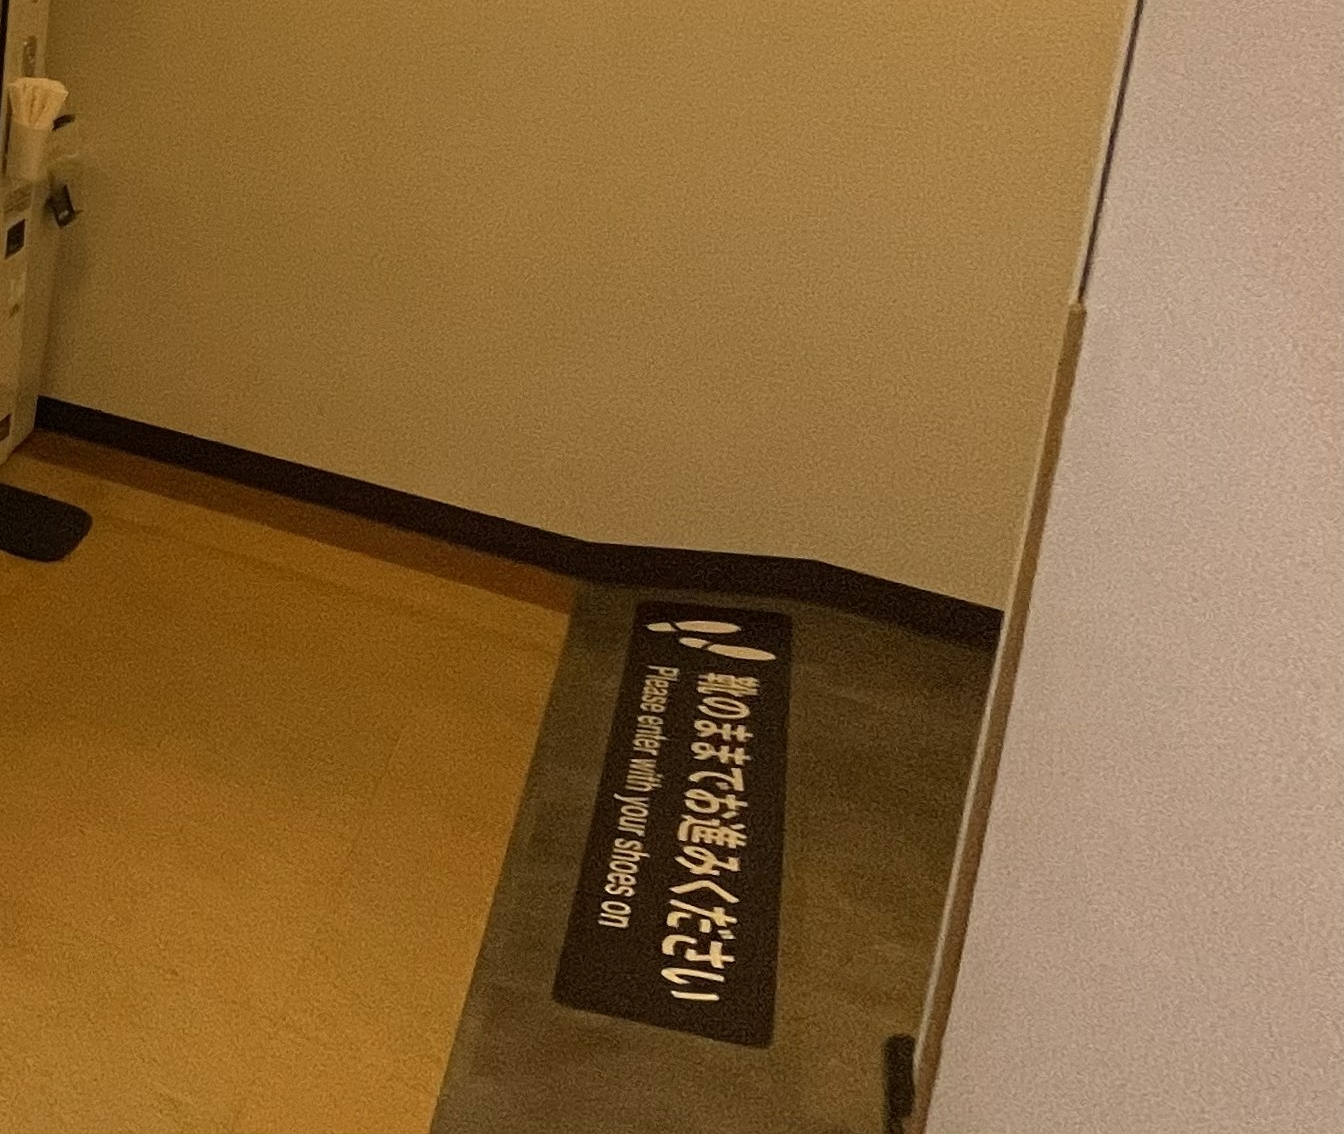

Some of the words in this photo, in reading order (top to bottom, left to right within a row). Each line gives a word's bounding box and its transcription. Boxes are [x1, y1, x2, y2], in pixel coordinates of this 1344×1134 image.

[648, 664, 679, 714] Please
[633, 714, 668, 757] enter
[625, 757, 664, 792] with
[613, 792, 650, 837] your
[659, 670, 762, 1002] 靴のままでお進みください
[604, 837, 651, 898] shoes
[597, 900, 632, 929] on
